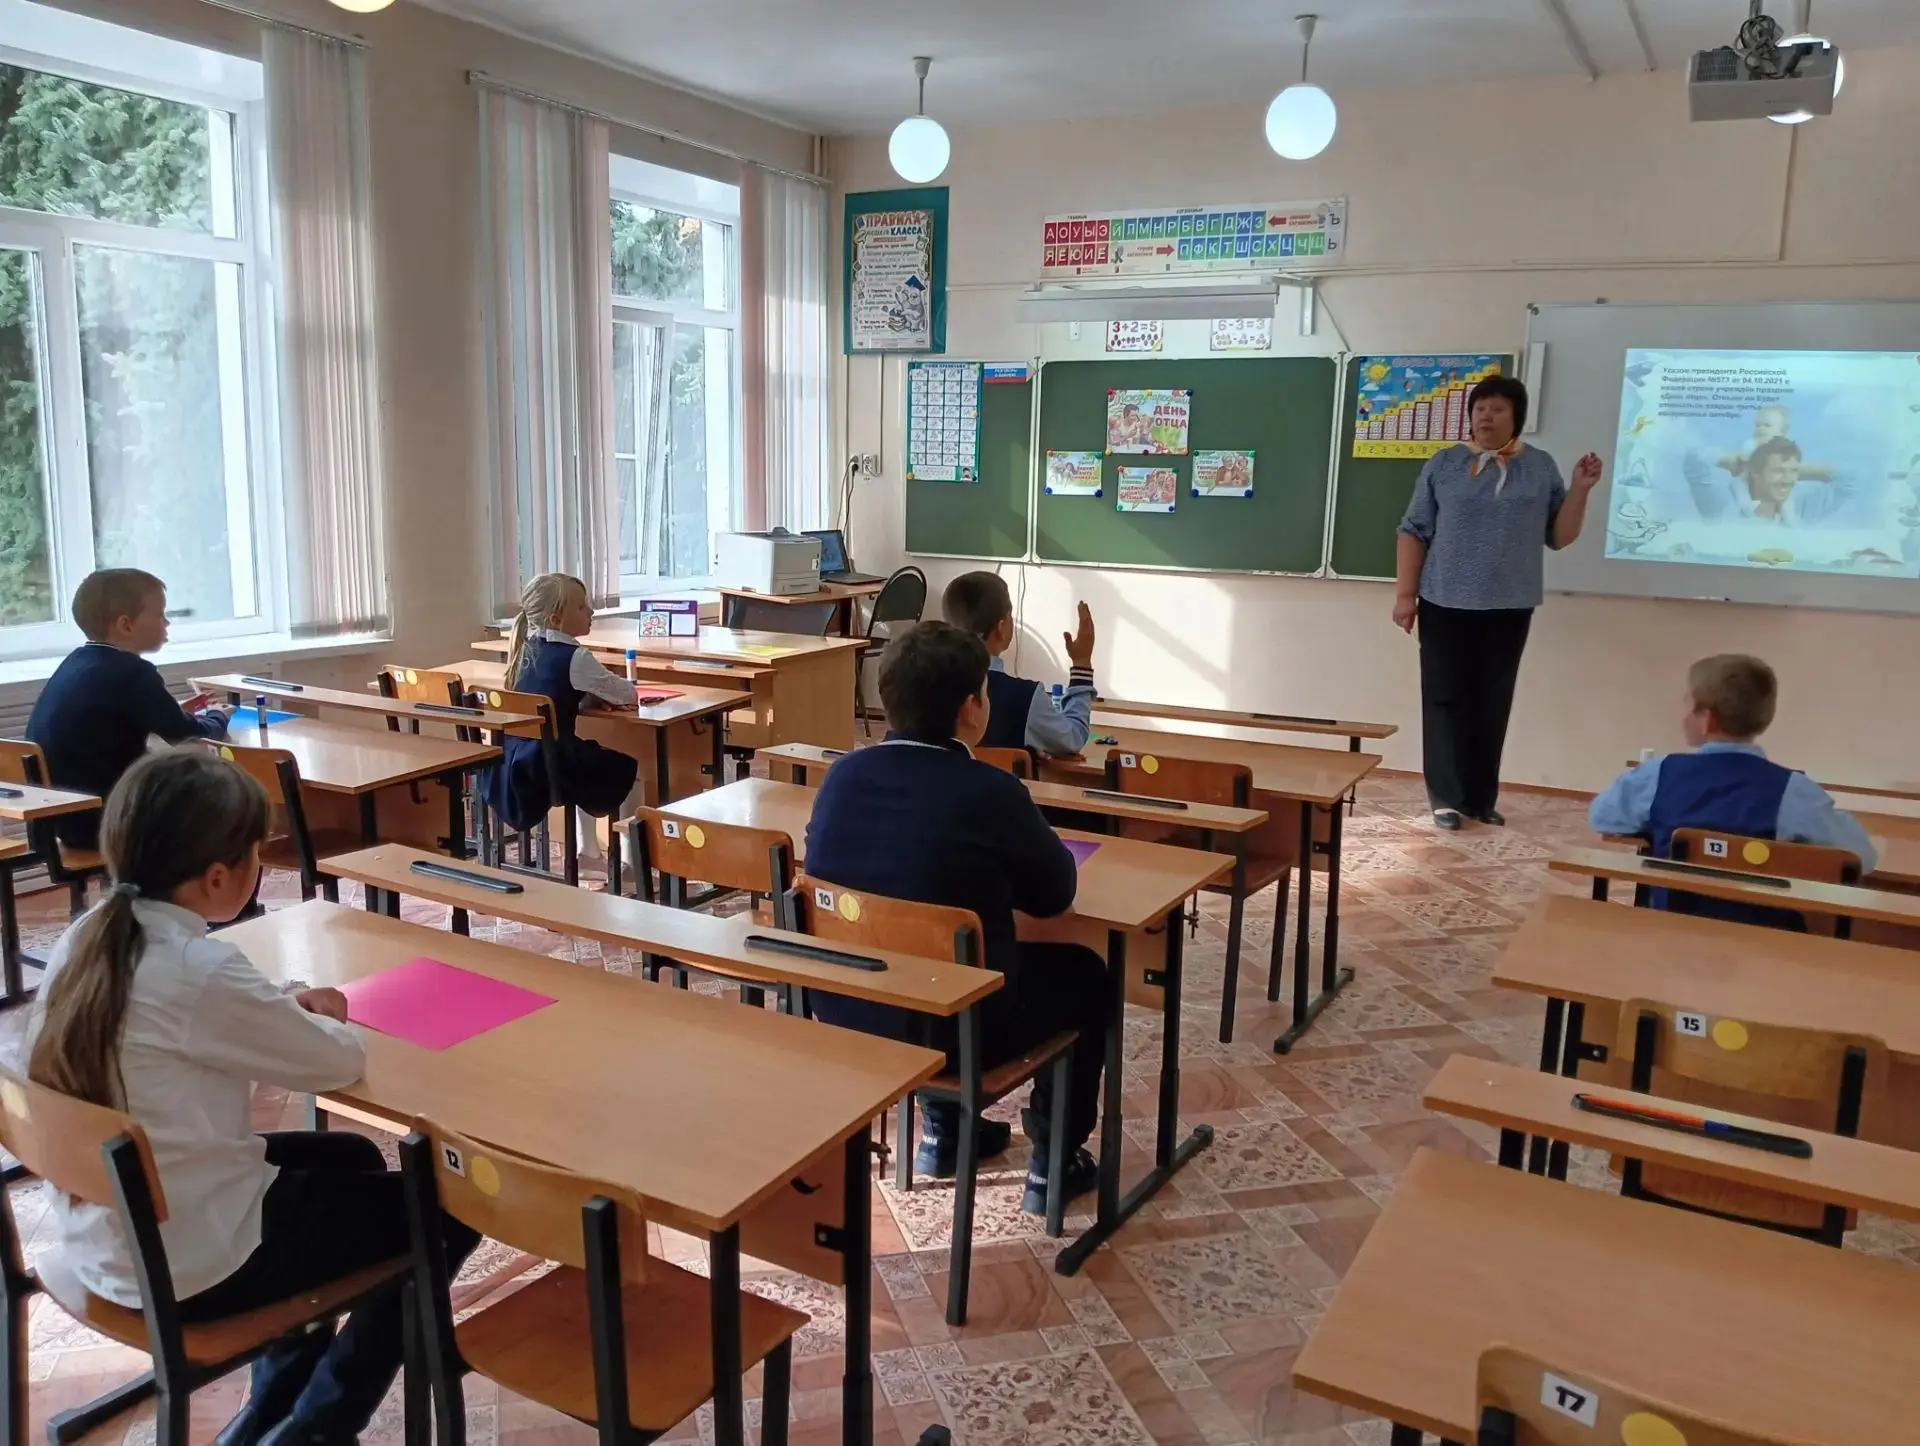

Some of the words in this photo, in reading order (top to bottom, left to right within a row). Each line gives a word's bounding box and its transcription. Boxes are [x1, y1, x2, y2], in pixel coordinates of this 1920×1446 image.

[866, 211, 921, 227] ПРАВИЛА
[1046, 228, 1055, 239] А
[1059, 227, 1068, 238] О
[1070, 227, 1081, 238] У
[1085, 226, 1095, 237] Ы
[1099, 225, 1107, 236] Э
[1127, 223, 1135, 234] Л
[1139, 223, 1149, 234] М
[1153, 222, 1162, 233] Н
[1168, 222, 1176, 233] Р
[1182, 220, 1190, 232] Б
[1196, 219, 1204, 232] В
[1211, 218, 1218, 230] Г
[1223, 217, 1234, 230] Д
[1238, 217, 1250, 230] Ж
[1254, 216, 1263, 229] З
[1329, 213, 1340, 225] Ъ
[891, 226, 922, 235] КЛАССА
[1045, 250, 1054, 261] Я
[1070, 248, 1081, 260] Ю
[1085, 248, 1093, 260] И
[1180, 244, 1188, 255] П
[1193, 243, 1203, 254] Ф
[1209, 243, 1216, 254] К
[1223, 242, 1231, 253] Т
[1237, 241, 1247, 252] Ш
[1252, 241, 1261, 252] С
[1268, 239, 1277, 250] Х
[1282, 239, 1292, 251] Ц
[1298, 238, 1306, 249] Ч
[1328, 239, 1337, 250] Ь
[1154, 406, 1187, 416] ДЕНЬ
[1155, 418, 1187, 428] ОТЦА
[667, 823, 675, 835] 9
[1709, 842, 1723, 853] 13
[818, 892, 832, 907] 10
[1683, 1017, 1700, 1031] 15
[445, 1149, 460, 1170] 12
[1555, 1385, 1586, 1412] 17
